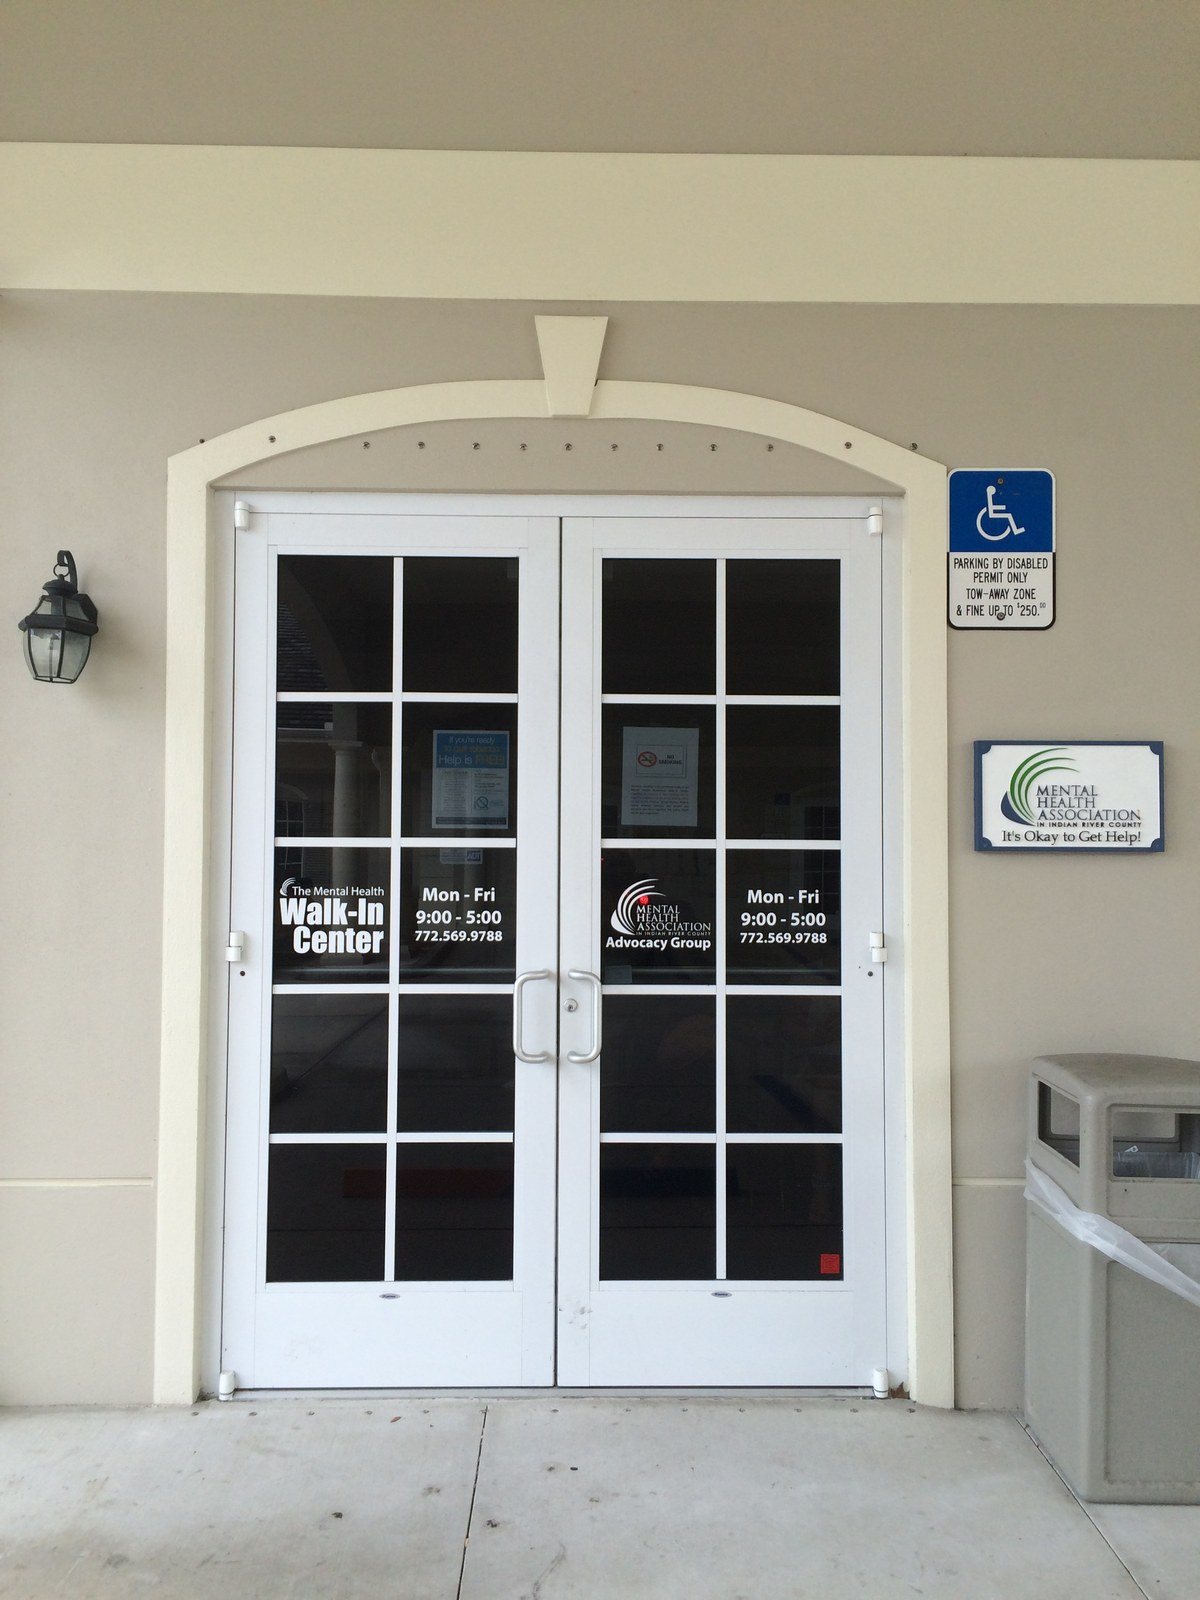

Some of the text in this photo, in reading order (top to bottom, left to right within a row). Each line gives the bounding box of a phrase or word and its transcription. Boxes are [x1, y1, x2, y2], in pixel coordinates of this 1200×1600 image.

[953, 557, 1049, 570] PARKING BY DISABLED
[973, 571, 1028, 583] PERMIT ONLY
[966, 588, 1036, 600] TOW-AWAY ZONE
[956, 604, 963, 616] &
[966, 604, 984, 616] FINE
[988, 604, 1000, 616] UP
[1002, 604, 1014, 616] TO
[438, 754, 462, 767] Help
[464, 754, 473, 765] is
[1036, 785, 1098, 797] MENTAL
[1036, 797, 1096, 809] HEALTH
[1038, 809, 1141, 821] ASSOCIATION
[1002, 830, 1142, 846] It's Okay to Get Help!
[292, 886, 385, 896] The Mental Health
[422, 887, 460, 902] Mon
[474, 886, 496, 902] Fri
[747, 889, 785, 904] Mon
[798, 888, 820, 904] Fri
[279, 898, 385, 926] Walk-In
[636, 904, 681, 914] MENTAL
[415, 909, 453, 925] 9:00
[465, 909, 502, 925] 5:00
[636, 913, 679, 923] HEALTH
[740, 912, 777, 927] 9:00
[790, 912, 827, 927] 5:00
[637, 922, 711, 931] ASSOCIATION
[293, 925, 385, 954] Center
[414, 930, 503, 942] 772.569.9788
[740, 932, 828, 944] 772.569.9788
[605, 936, 712, 951] Advocacy Group
